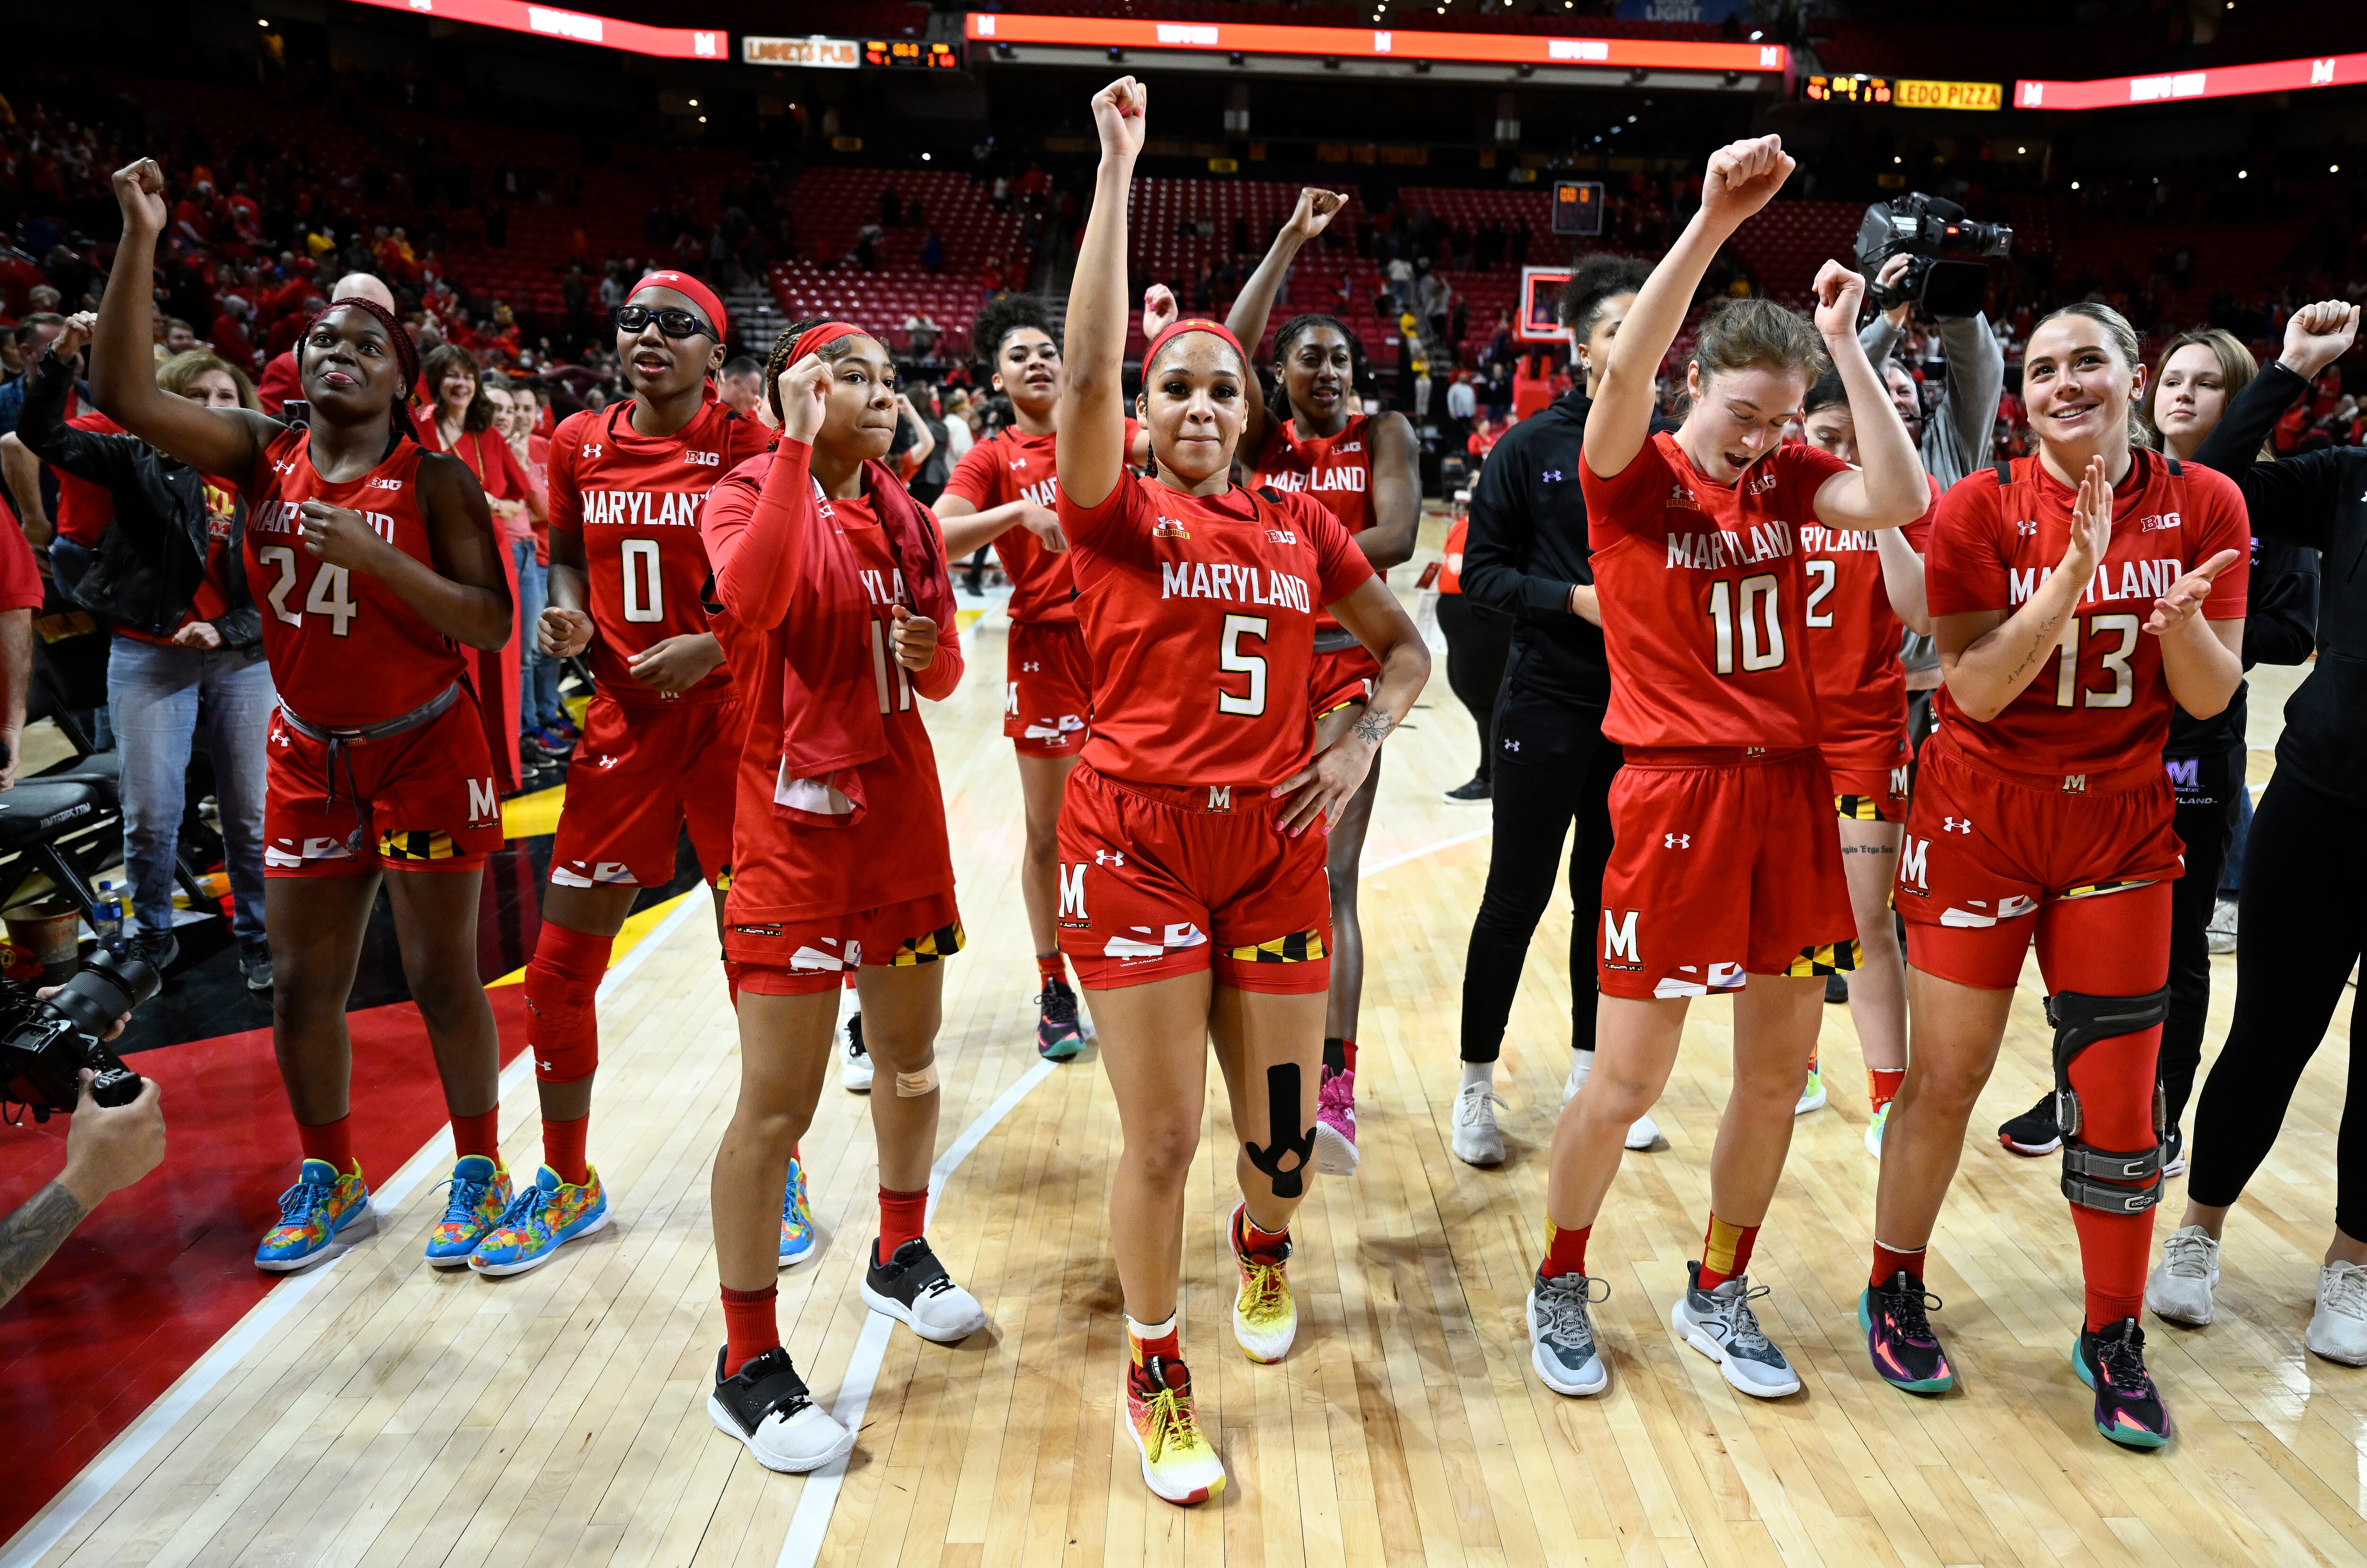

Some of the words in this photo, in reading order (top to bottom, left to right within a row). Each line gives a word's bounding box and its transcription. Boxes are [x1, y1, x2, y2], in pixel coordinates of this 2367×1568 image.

[820, 45, 855, 62] PUB
[1896, 84, 1941, 104] LEDO
[1947, 86, 1998, 105] PIZZA
[1668, 499, 1700, 510] GRADUATE
[1665, 521, 1793, 570] MARYLAND
[259, 545, 356, 636] 24
[621, 538, 664, 623] 0
[1161, 561, 1310, 614] MARYLAND
[1707, 572, 1786, 676] 10
[1218, 612, 1268, 718] 5
[2056, 612, 2140, 708] 13
[467, 777, 499, 822] M
[1207, 786, 1231, 809] M
[1889, 764, 1908, 796] M
[1900, 834, 1930, 890] M
[1059, 862, 1089, 919] M
[1139, 957, 1163, 965] ARMOUR
[1604, 909, 1642, 963] M
